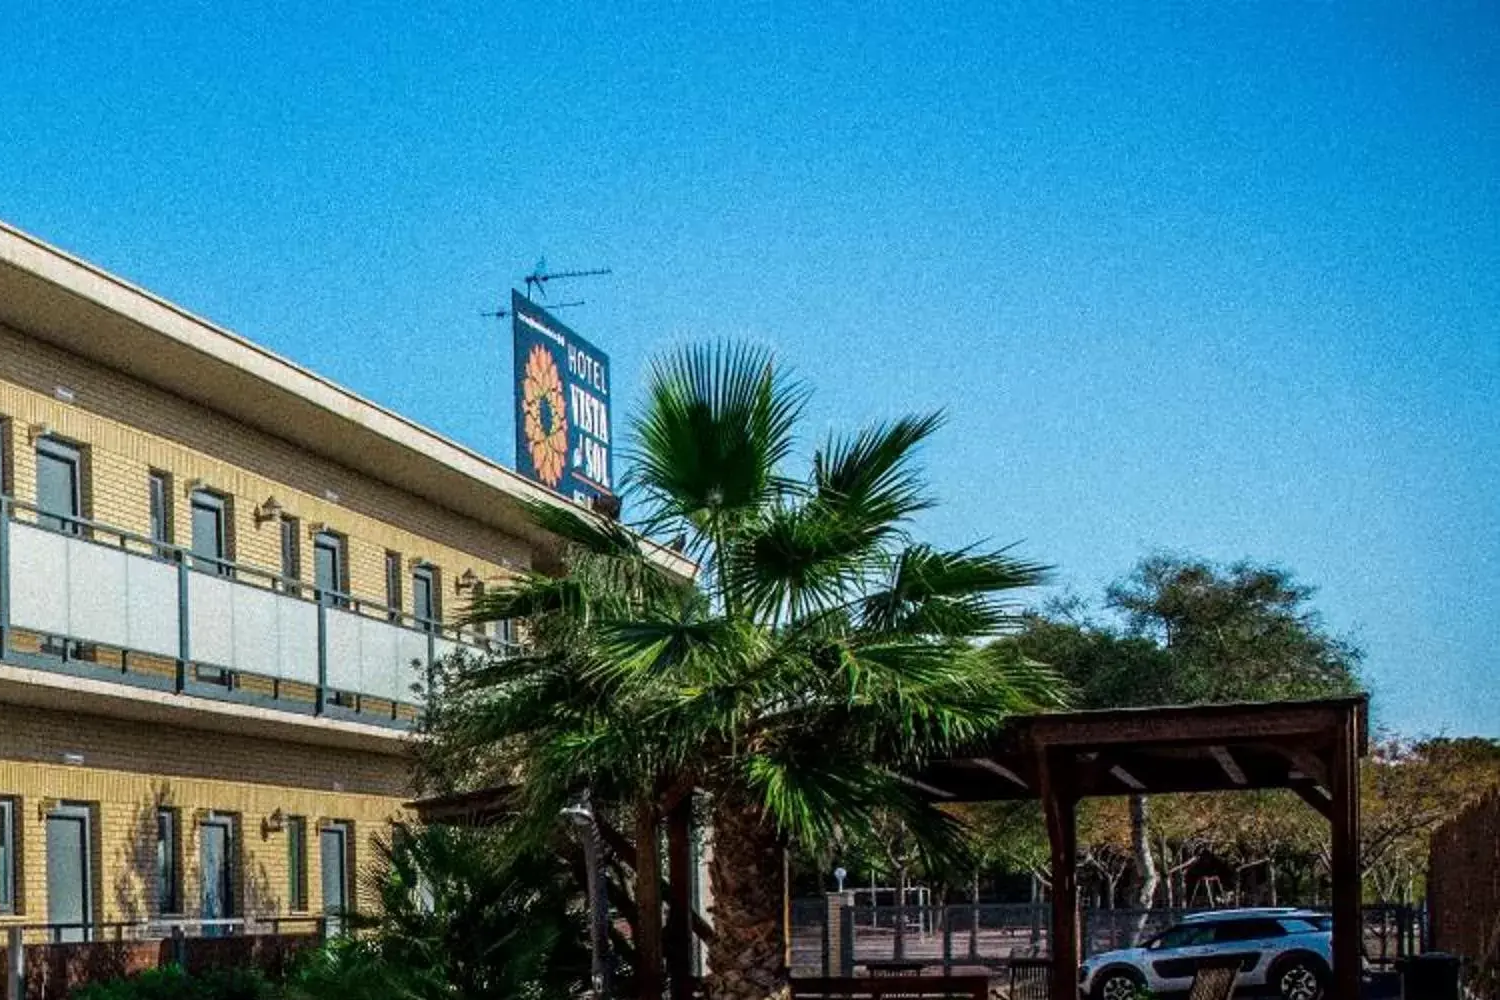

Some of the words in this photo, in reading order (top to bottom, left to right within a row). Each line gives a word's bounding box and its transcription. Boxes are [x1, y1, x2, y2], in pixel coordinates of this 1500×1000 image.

[567, 343, 607, 395] HOTEL
[570, 383, 609, 444] VISTA
[585, 437, 610, 488] SOL
